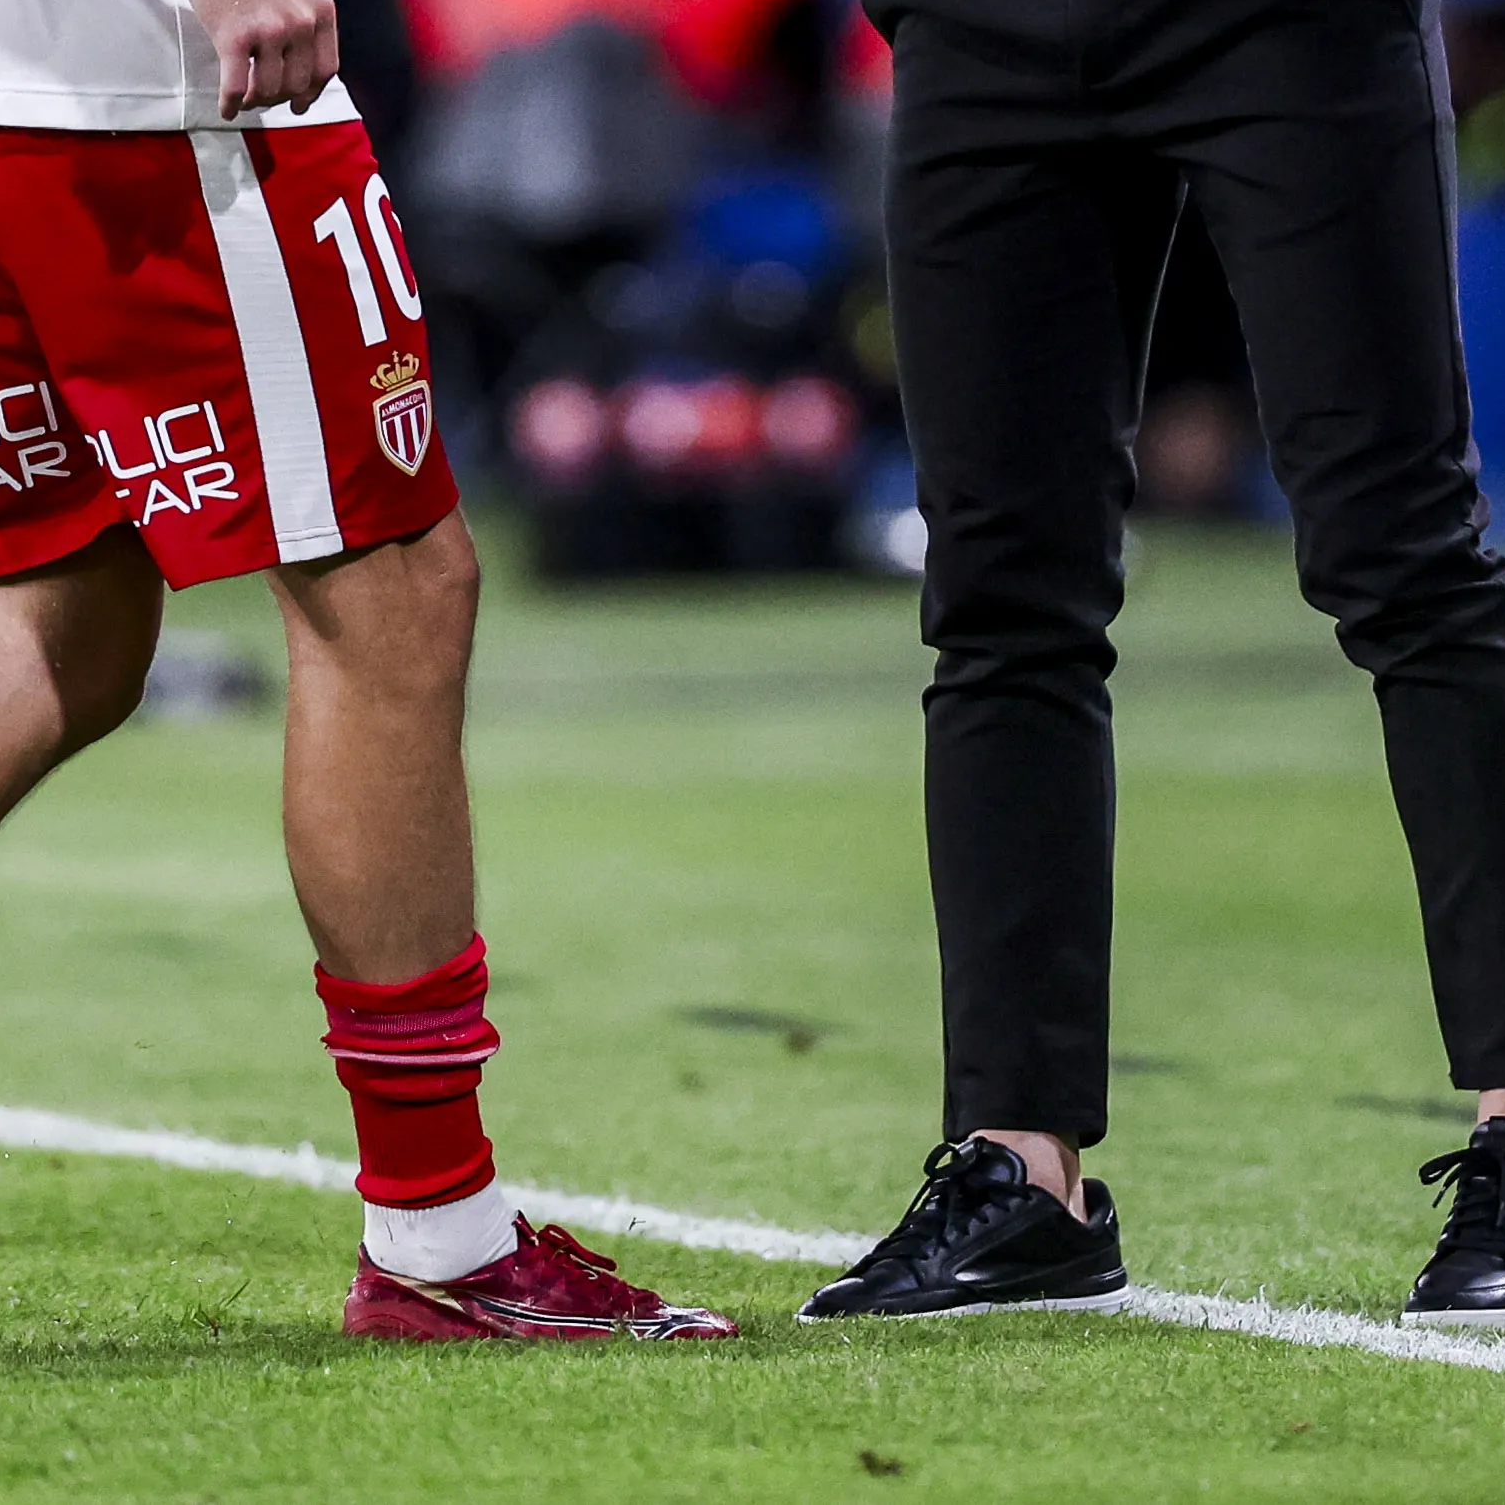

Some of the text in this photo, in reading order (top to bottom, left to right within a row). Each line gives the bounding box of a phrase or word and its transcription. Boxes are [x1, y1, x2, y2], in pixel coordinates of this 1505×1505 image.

[313, 173, 422, 347] 10
[84, 400, 225, 480] LICI
[115, 461, 240, 528] AR
